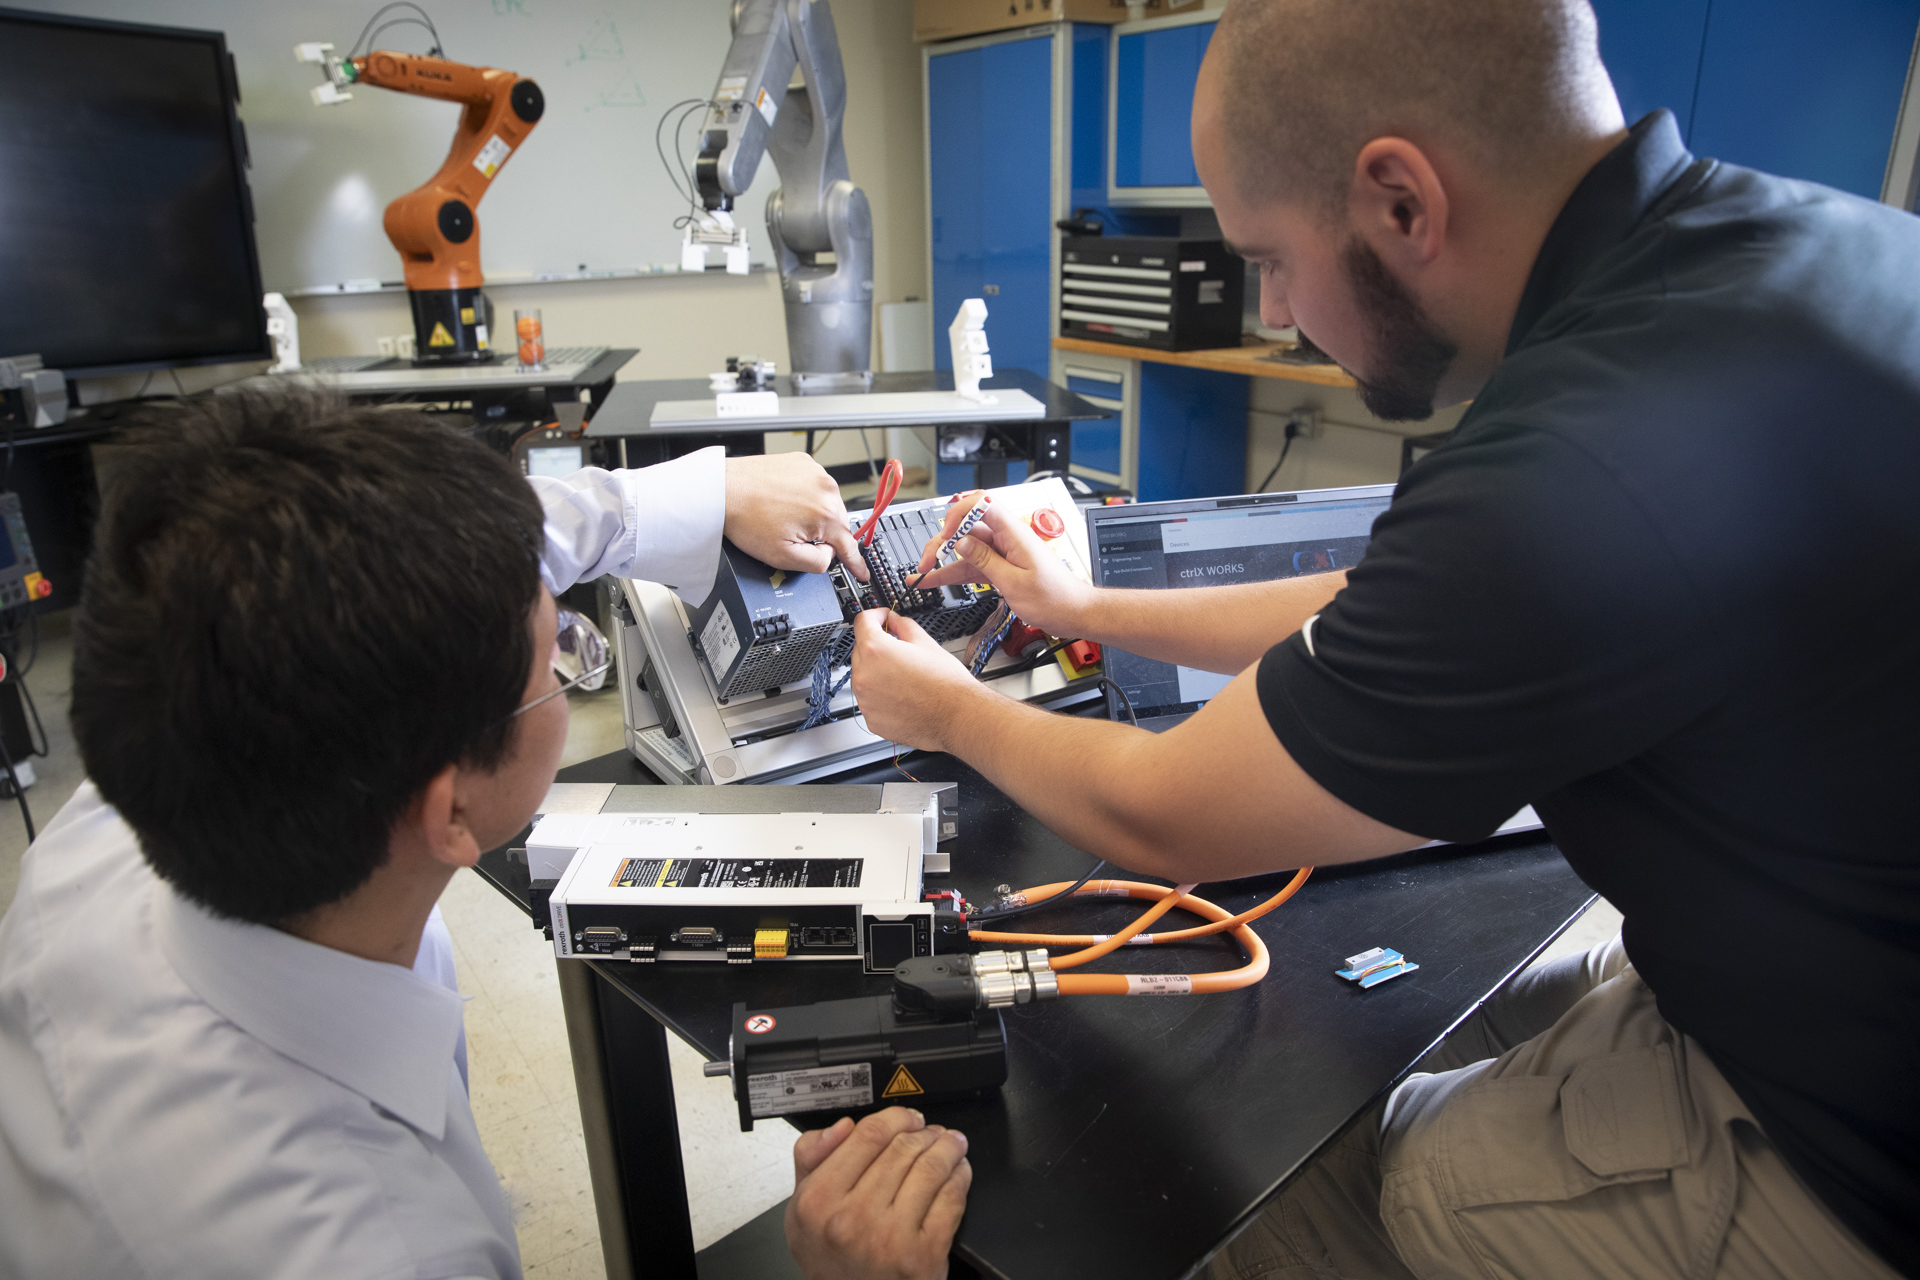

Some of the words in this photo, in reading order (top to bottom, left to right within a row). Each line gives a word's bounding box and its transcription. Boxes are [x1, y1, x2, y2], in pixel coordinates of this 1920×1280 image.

[942, 508, 982, 555] rexroth
[1180, 565, 1205, 578] ctrlX
[1207, 563, 1245, 575] WORKS
[556, 905, 564, 919] DRIVE
[558, 930, 568, 956] rexroth
